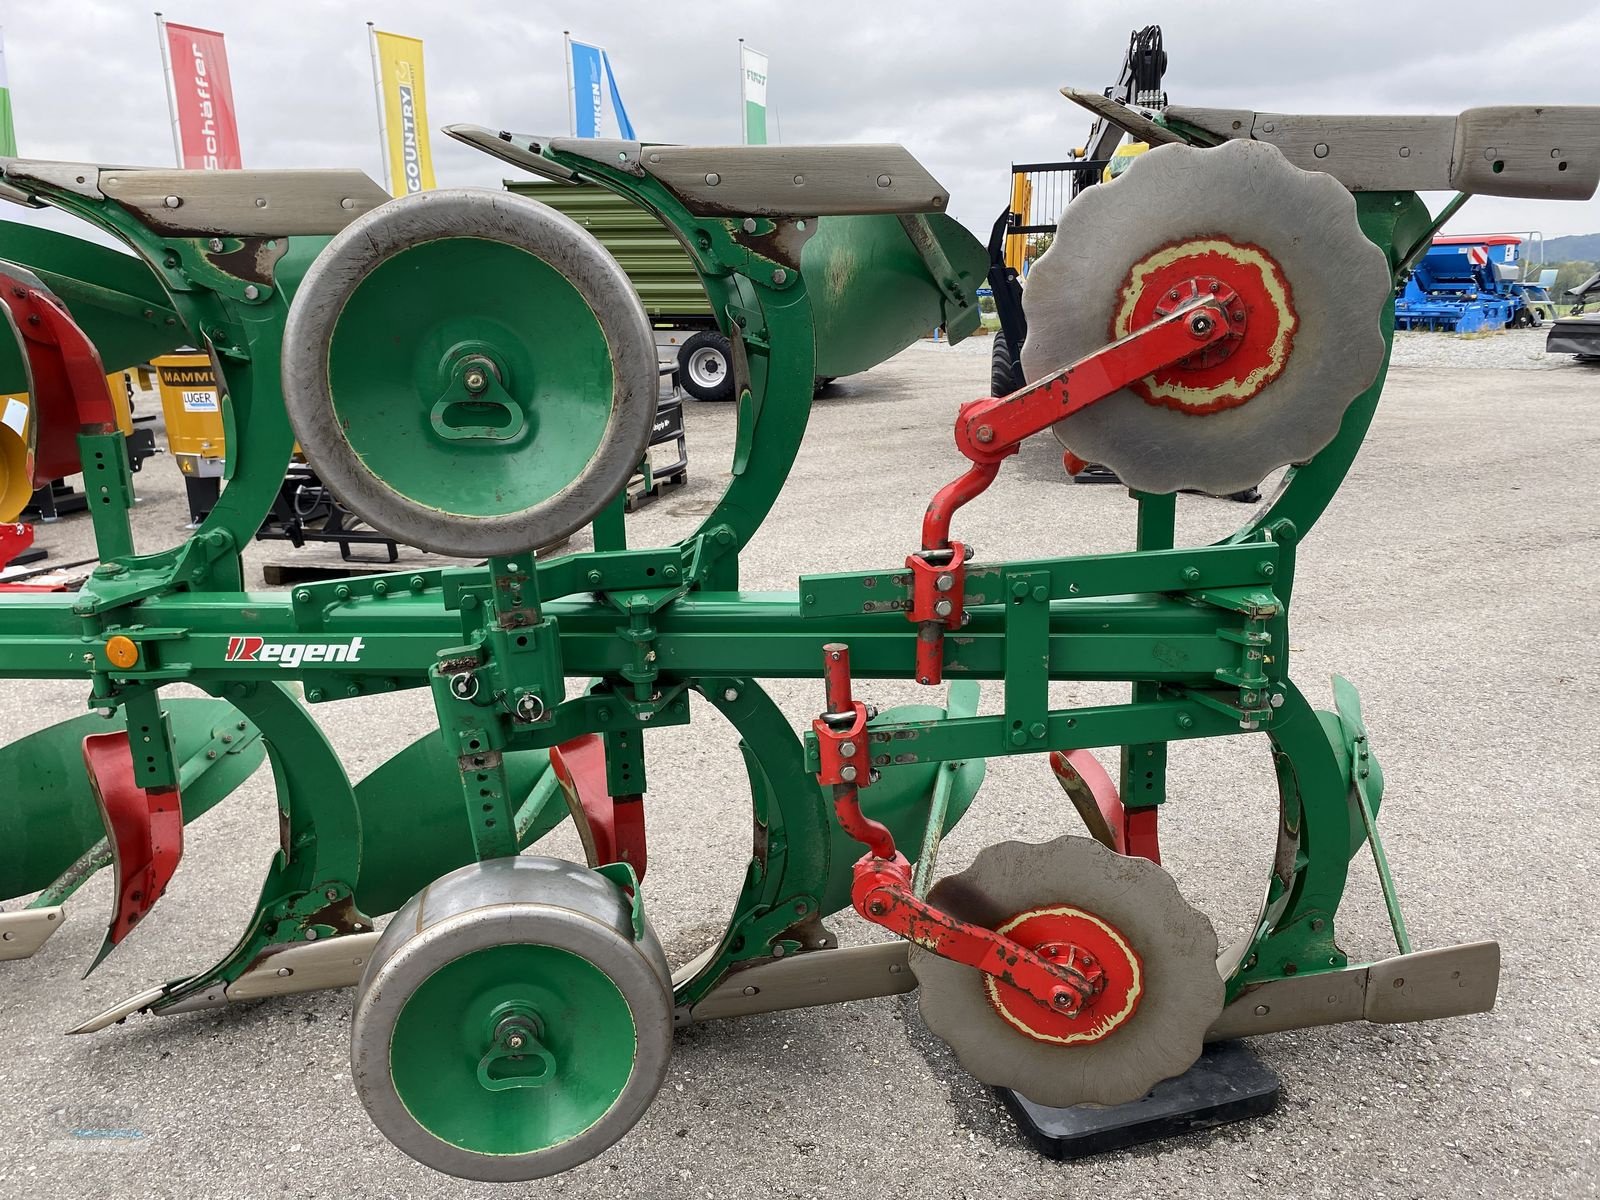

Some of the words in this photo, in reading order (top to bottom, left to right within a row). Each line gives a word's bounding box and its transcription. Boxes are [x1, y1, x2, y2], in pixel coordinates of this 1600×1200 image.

[192, 42, 218, 170] Schäffer
[400, 88, 421, 193] COUNTRY
[184, 392, 212, 403] LUGER
[225, 636, 365, 668] Regent
